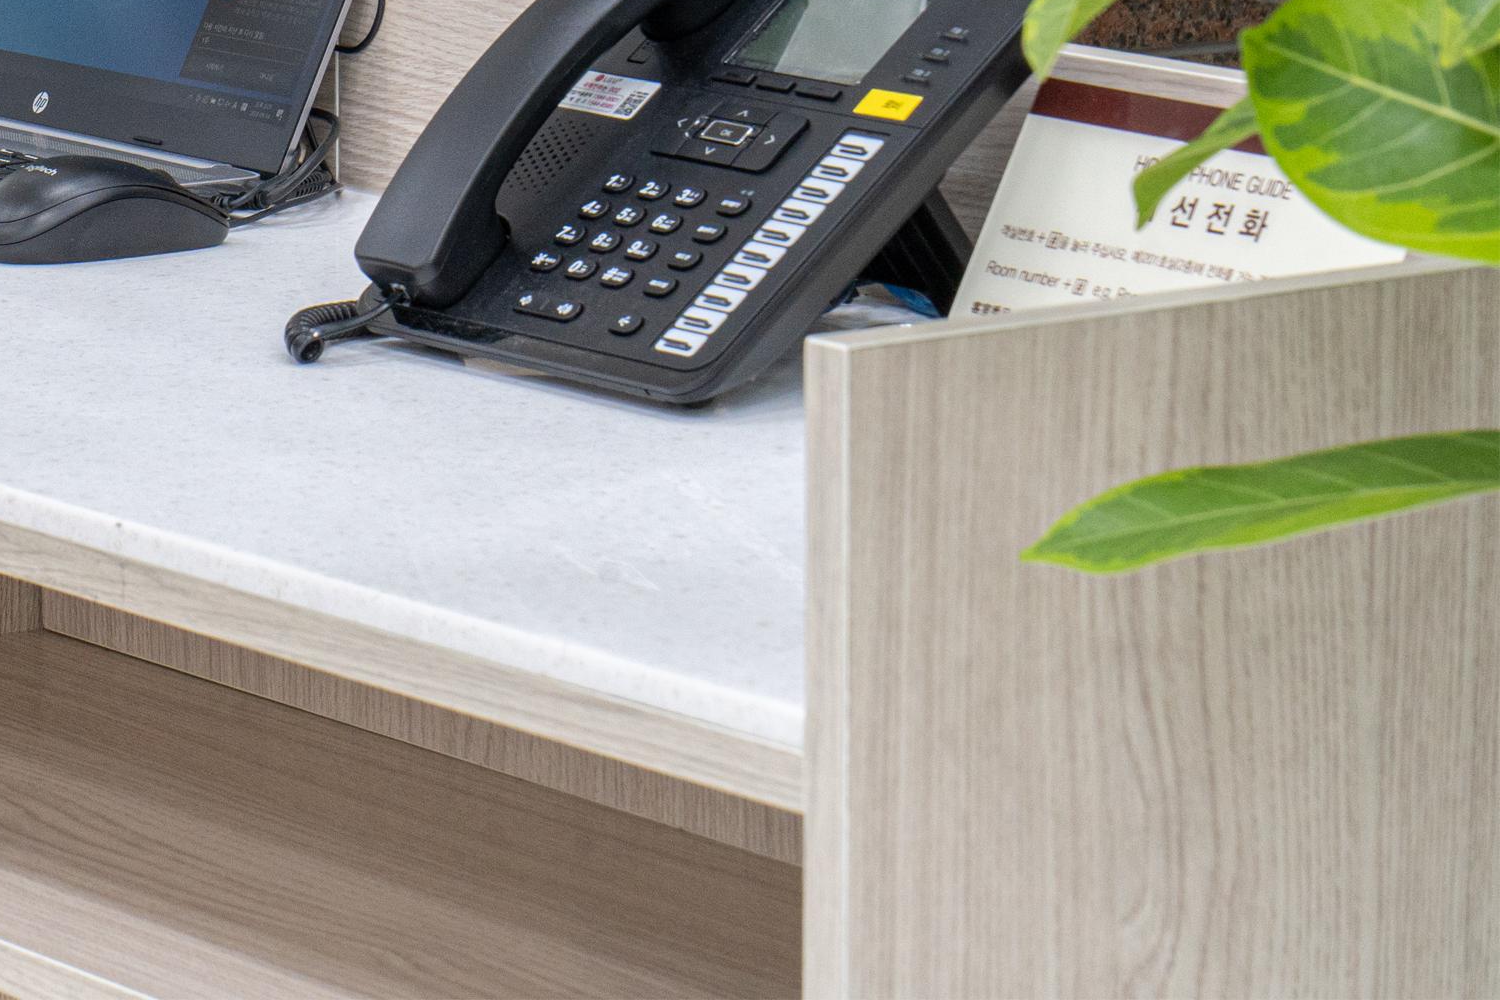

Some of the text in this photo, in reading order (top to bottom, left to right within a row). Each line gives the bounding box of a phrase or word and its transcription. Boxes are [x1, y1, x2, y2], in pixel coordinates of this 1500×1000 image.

[33, 91, 50, 113] hp
[1188, 164, 1245, 192] PHONE
[1245, 175, 1295, 201] GUIDE
[1149, 194, 1270, 244] 선전화
[986, 259, 1018, 278] Room
[1019, 269, 1061, 288] number
